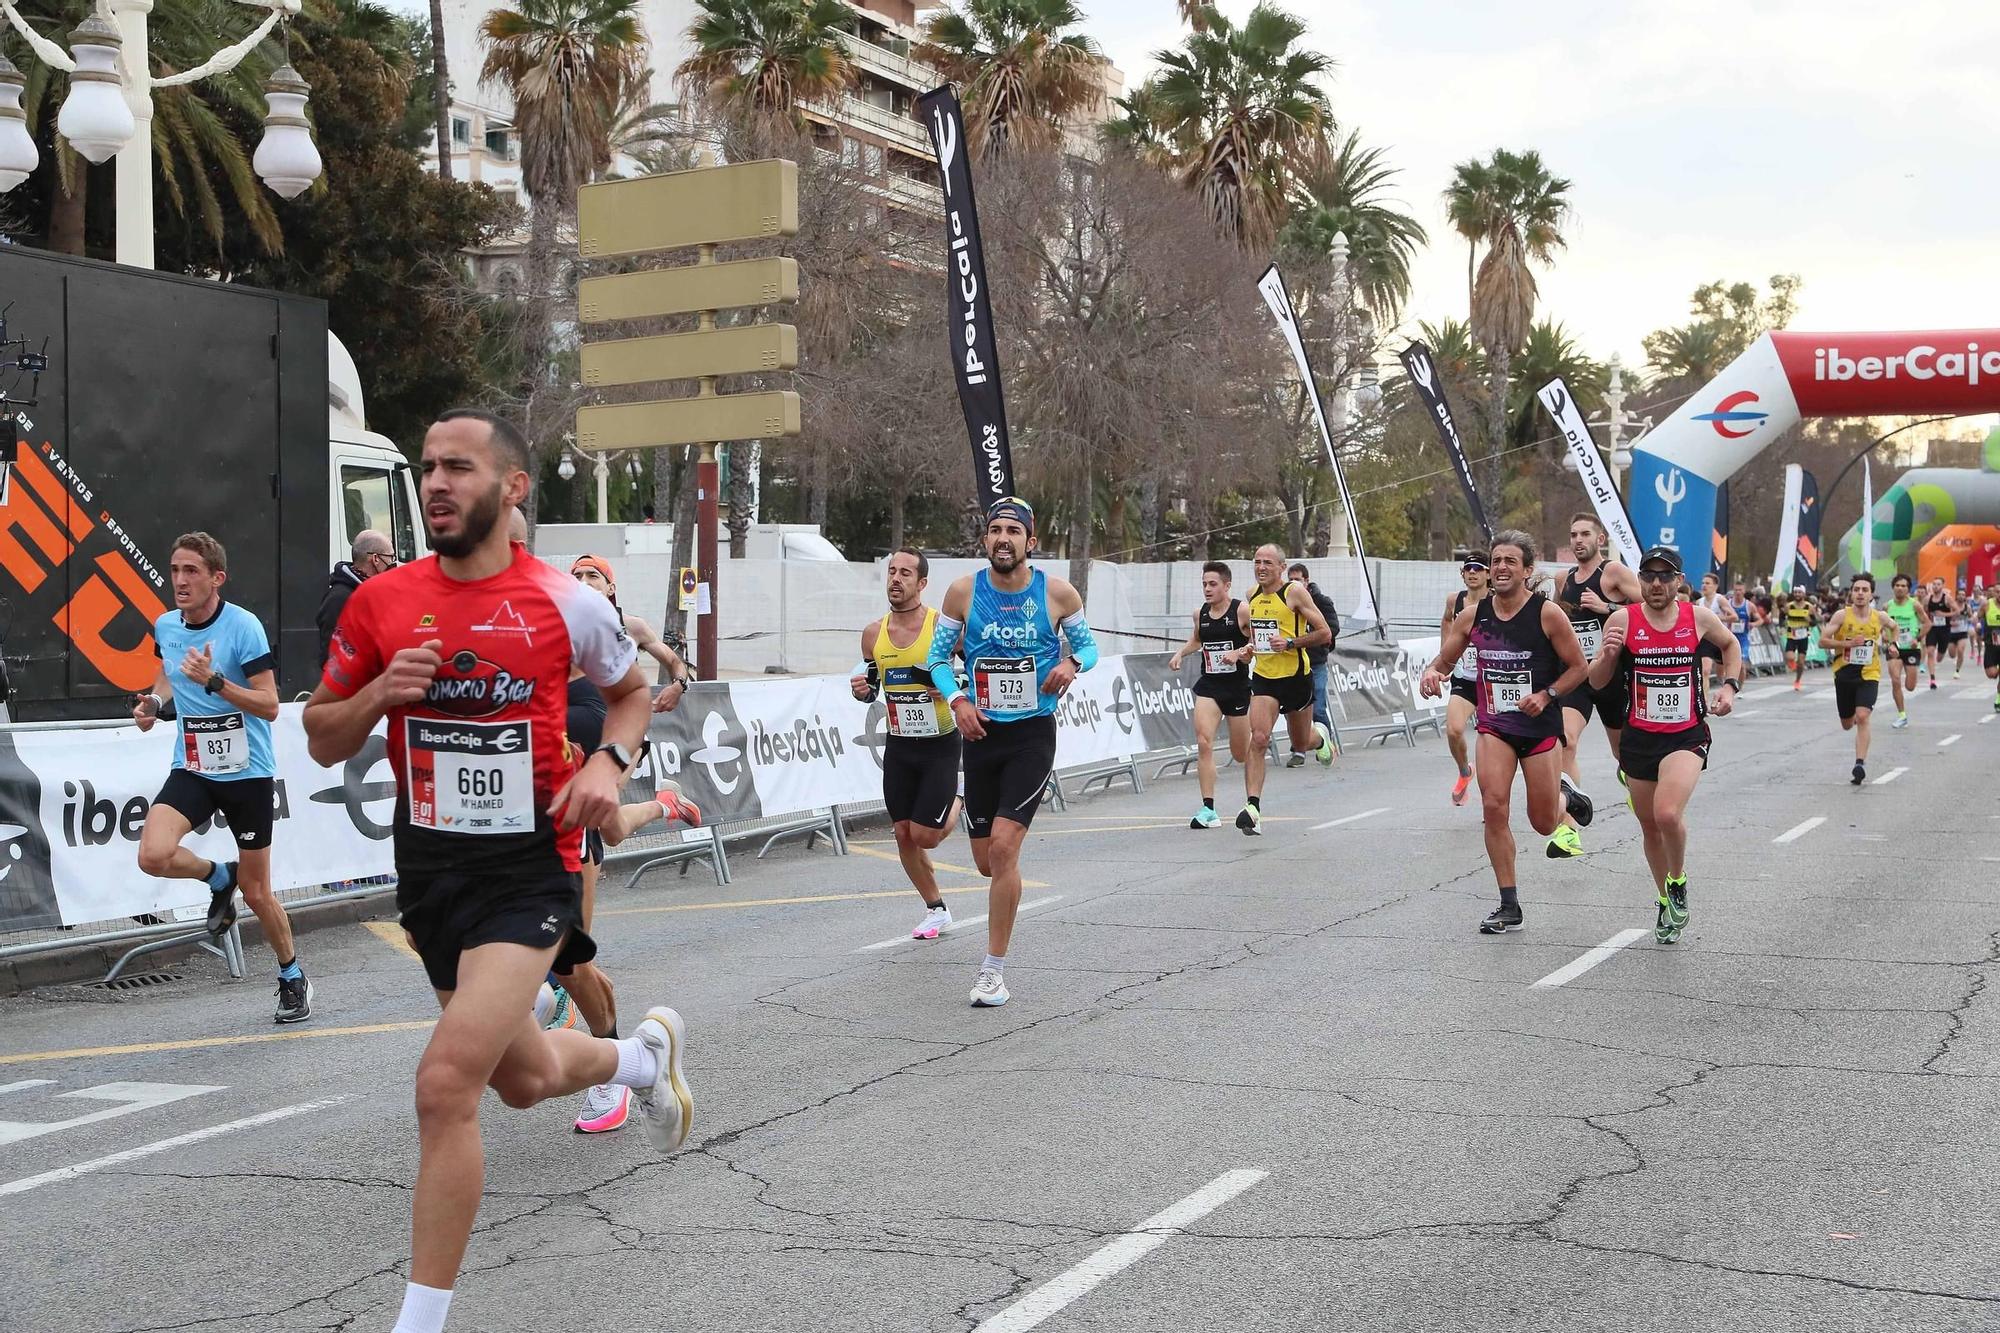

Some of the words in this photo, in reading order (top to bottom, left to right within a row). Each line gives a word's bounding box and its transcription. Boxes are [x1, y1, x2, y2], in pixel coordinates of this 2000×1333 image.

[16, 411, 34, 432] DE
[100, 510, 165, 588] DEPORTIVOS
[1002, 639, 1037, 648] logistic
[1638, 646, 1673, 655] atletismo
[1675, 645, 1690, 654] club
[1634, 656, 1693, 666] MANCHATHON
[999, 679, 1024, 694] 573
[1501, 689, 1521, 701] 856
[1657, 693, 1680, 706] 838
[905, 709, 925, 721] 338
[420, 728, 483, 749] iberCaja
[750, 714, 845, 769] iberCaja
[207, 738, 231, 755] 837
[457, 767, 504, 797] 660
[461, 798, 504, 810] M'HAMED
